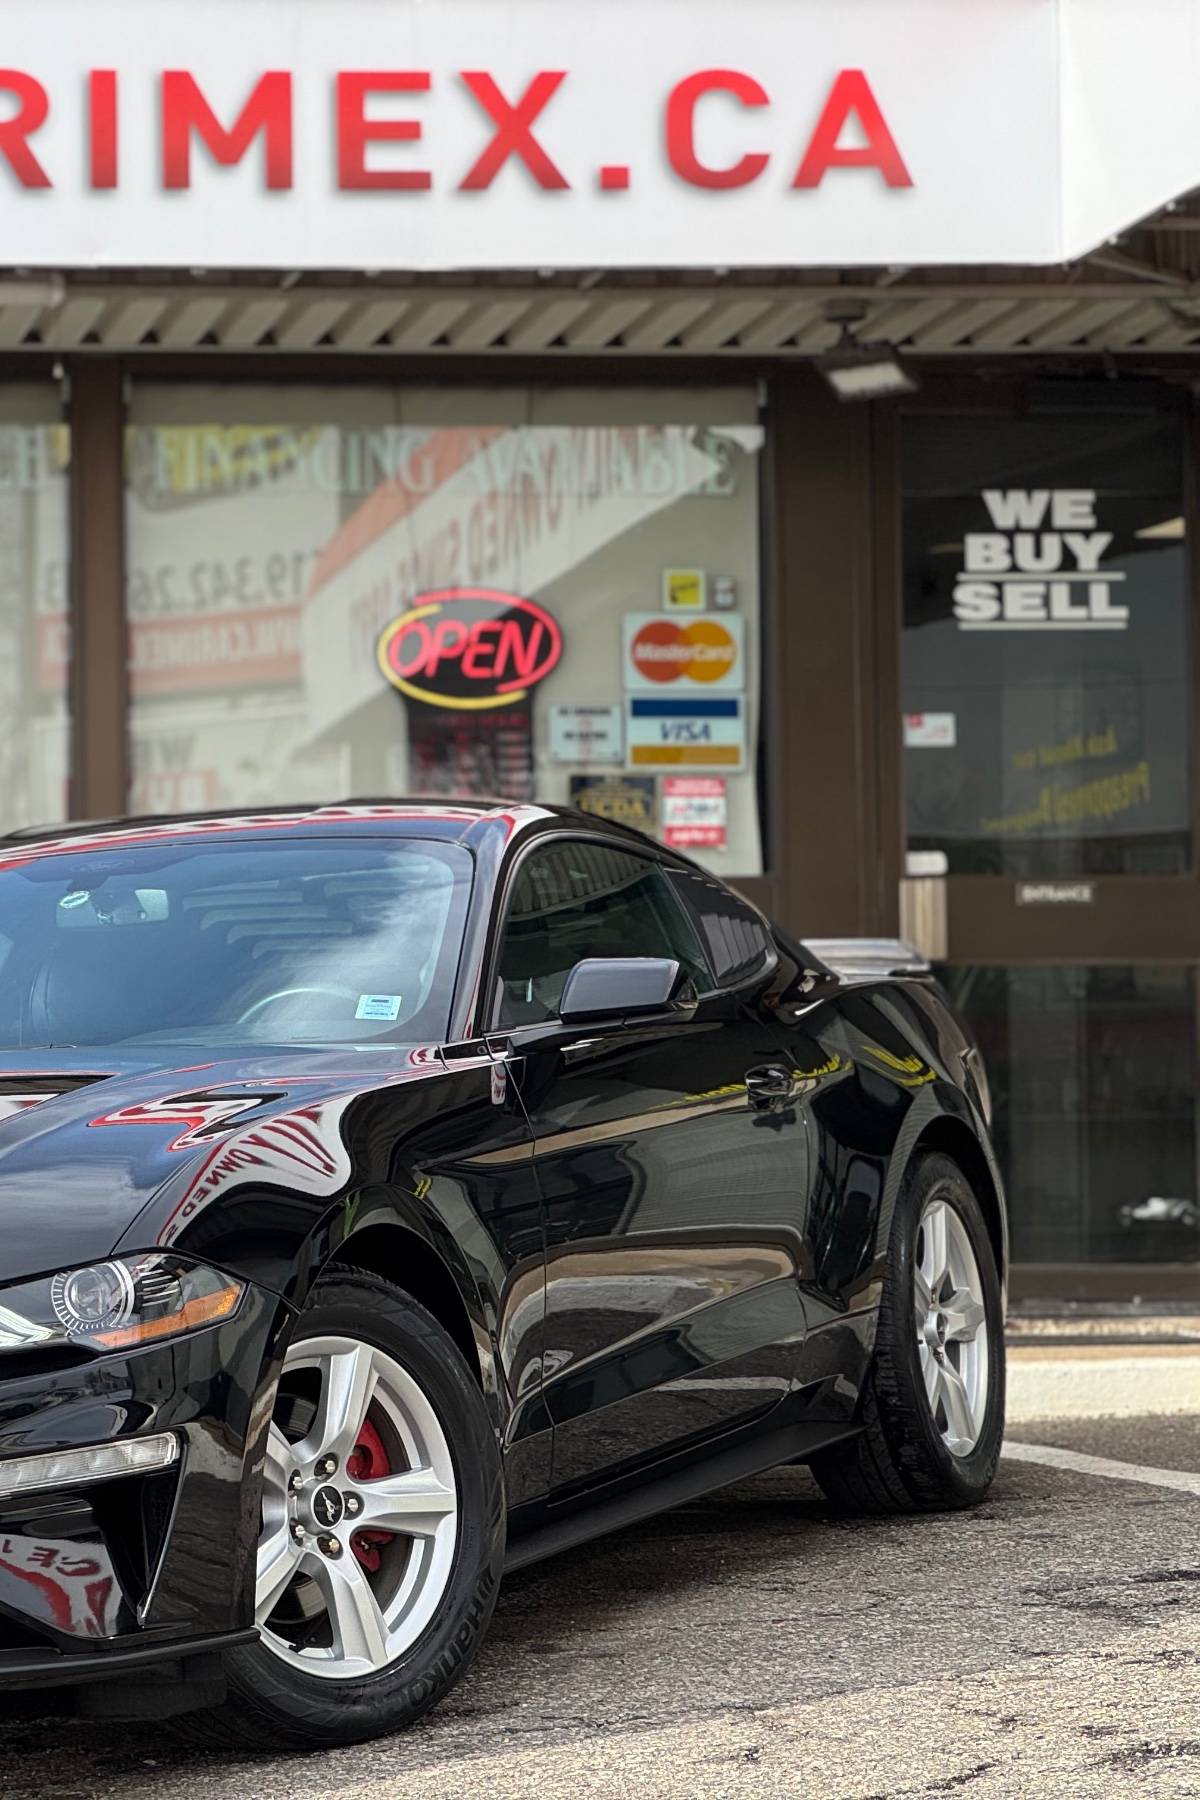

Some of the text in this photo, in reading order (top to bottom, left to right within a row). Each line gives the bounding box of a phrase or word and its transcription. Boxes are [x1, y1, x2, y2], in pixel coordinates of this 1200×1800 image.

[154, 428, 436, 494] FINANCING
[982, 490, 1097, 529] WE
[964, 533, 1113, 573] BUY
[953, 581, 1129, 621] SELL
[388, 620, 544, 678] OPEN
[635, 642, 734, 662] MasterCard
[660, 722, 712, 741] VISA
